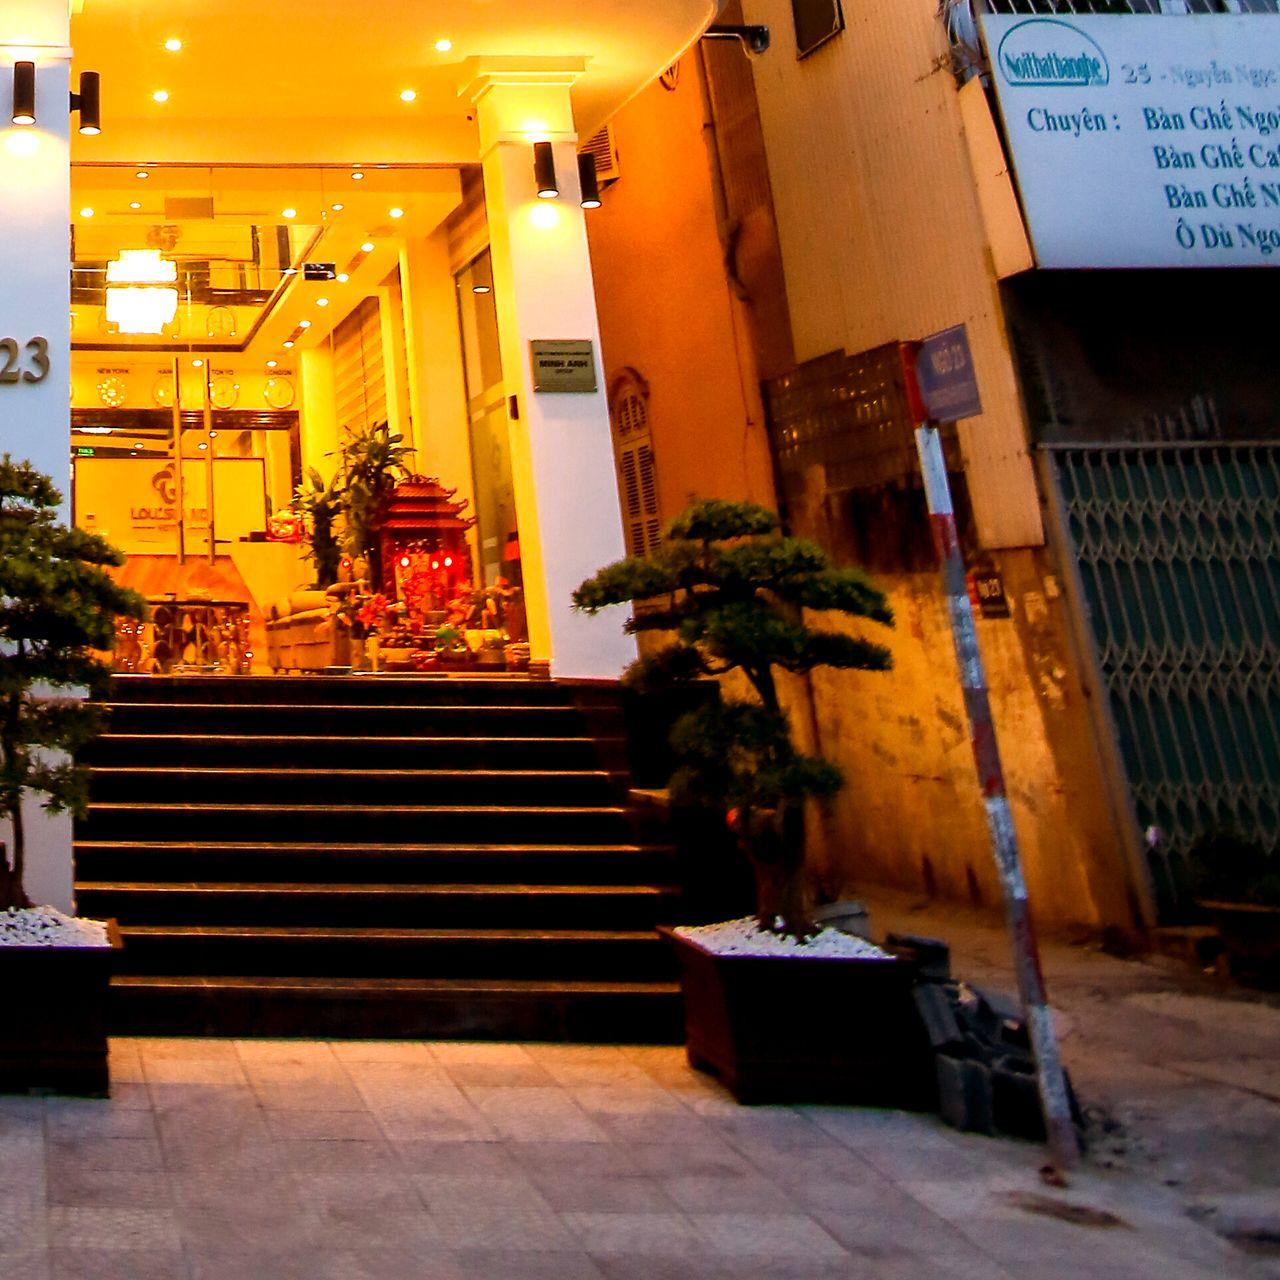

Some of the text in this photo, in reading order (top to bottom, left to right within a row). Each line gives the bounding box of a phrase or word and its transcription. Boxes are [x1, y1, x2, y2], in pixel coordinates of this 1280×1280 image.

[1142, 105, 1185, 130] Bàn
[1190, 99, 1233, 131] Ghế
[1153, 136, 1280, 169] Bàn Ghế Ca
[1164, 183, 1208, 208] Bàn
[1213, 176, 1256, 208] Ghế
